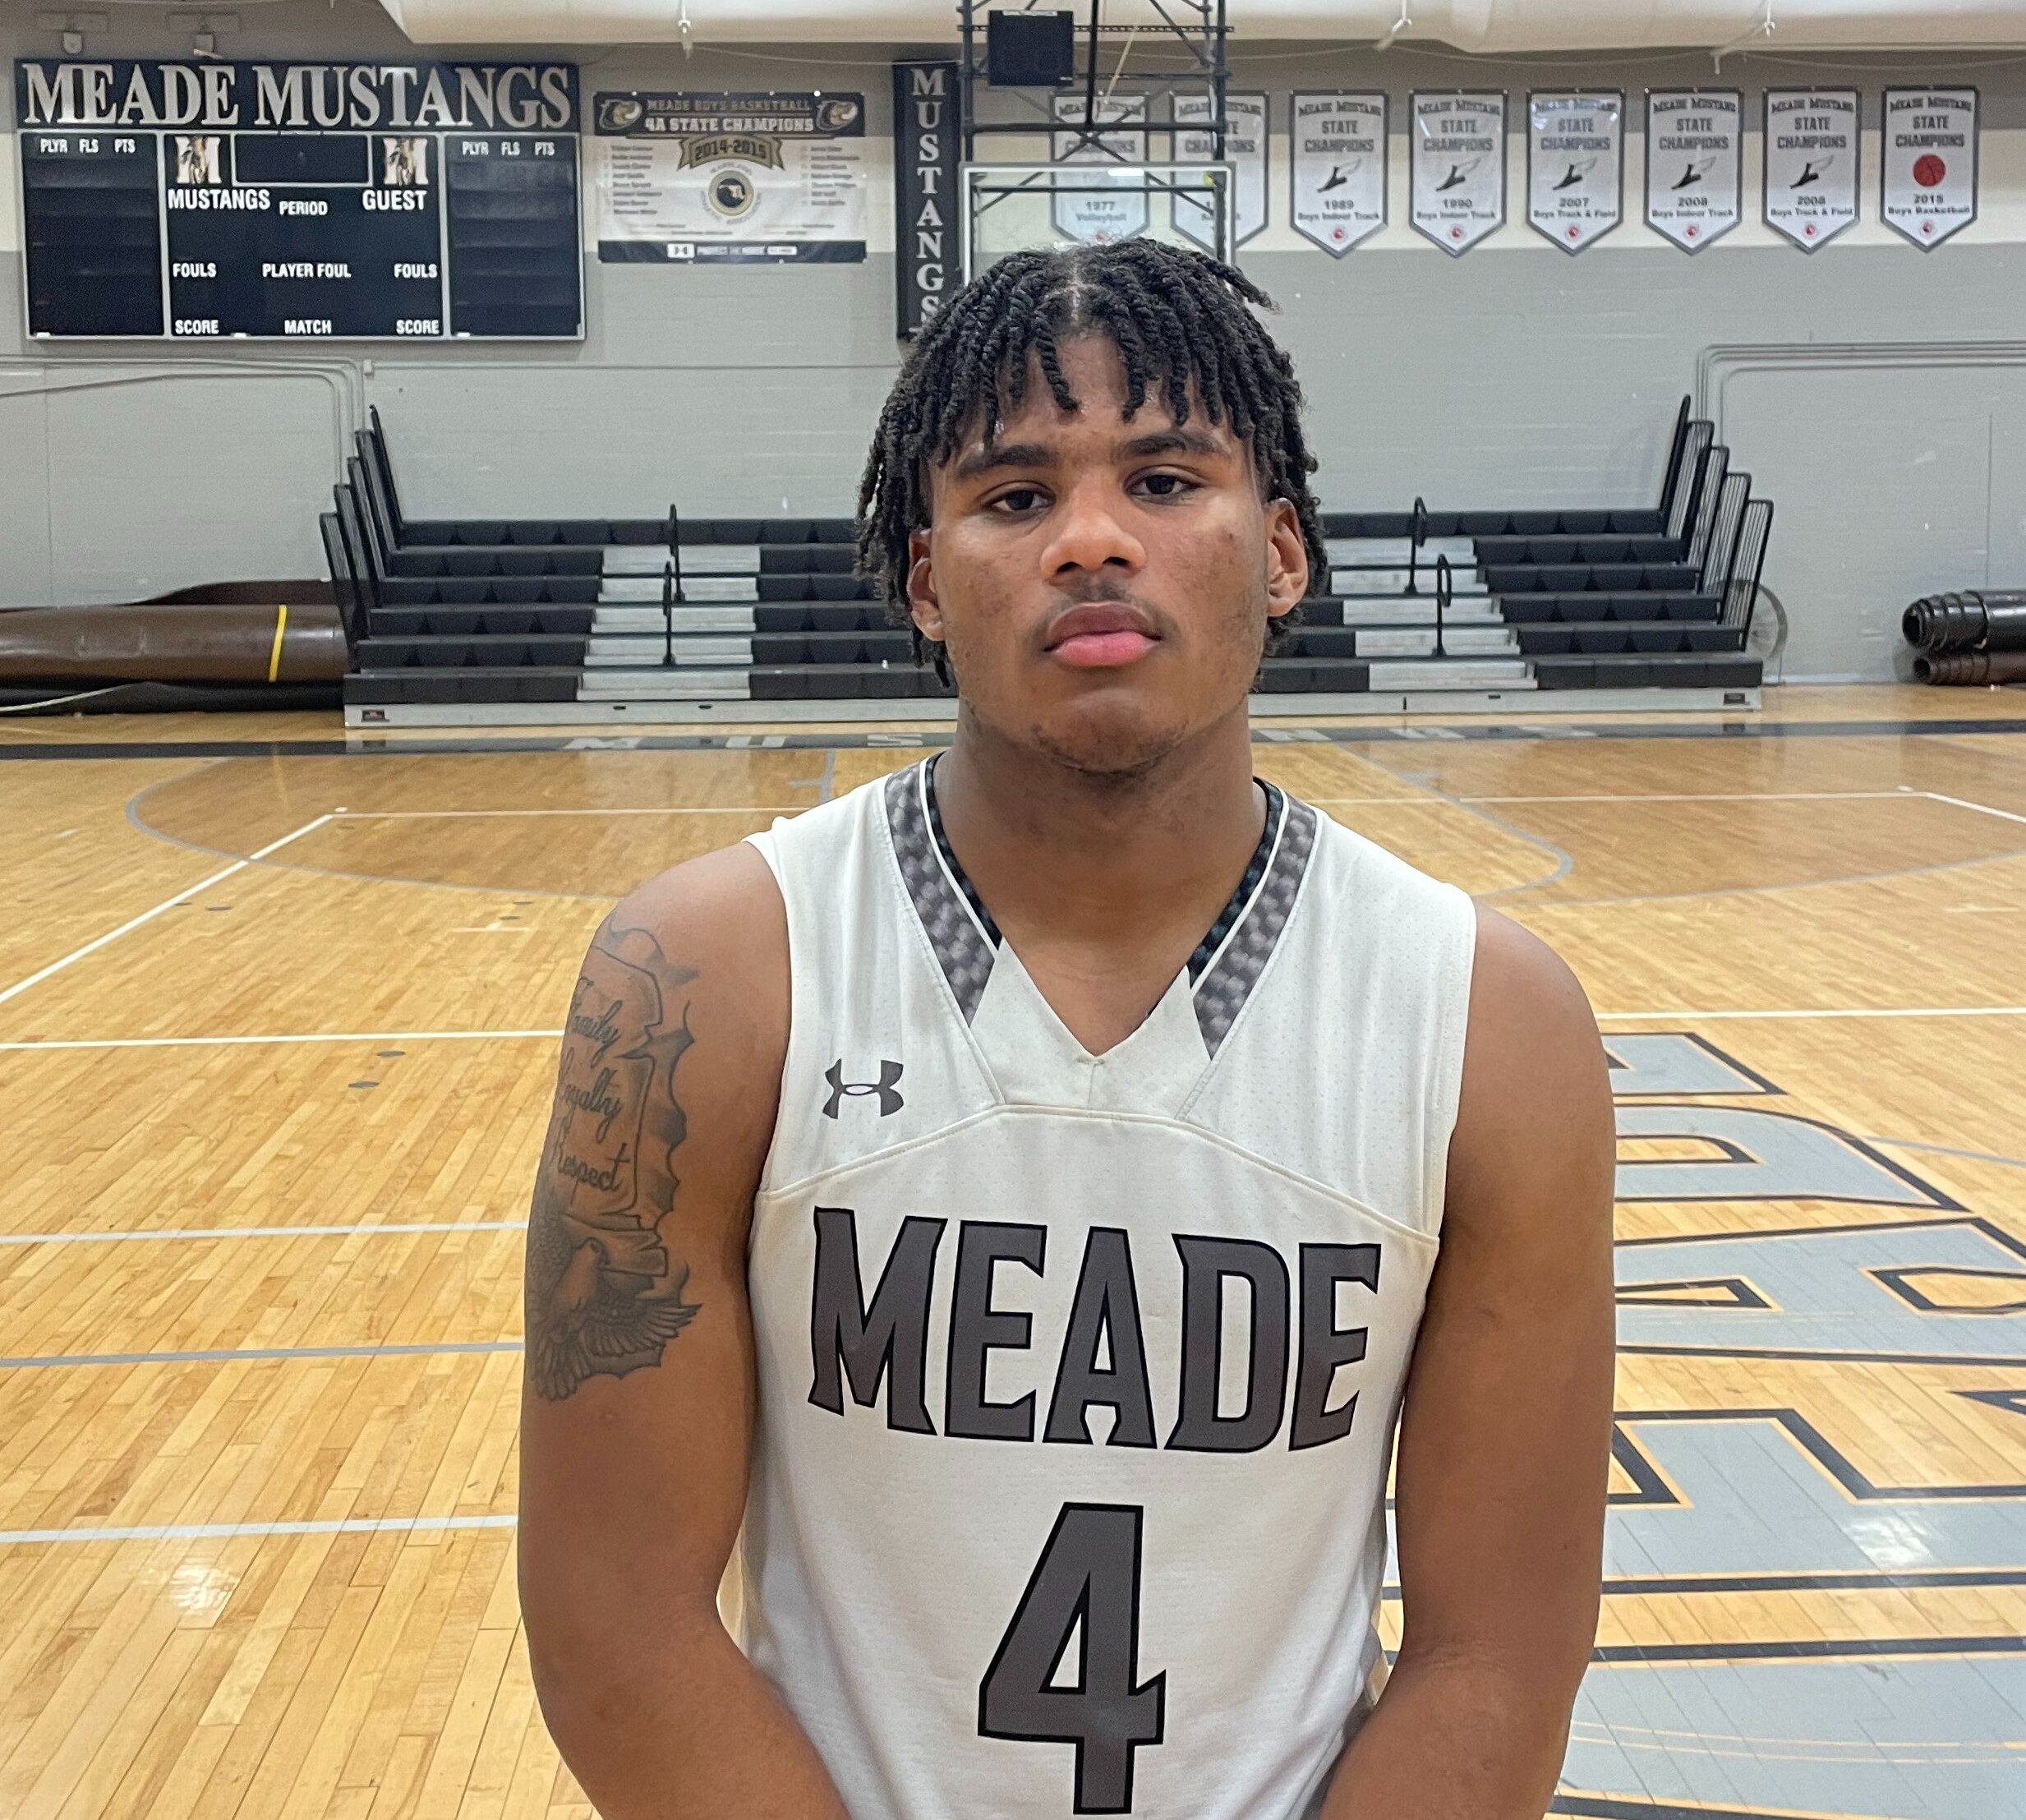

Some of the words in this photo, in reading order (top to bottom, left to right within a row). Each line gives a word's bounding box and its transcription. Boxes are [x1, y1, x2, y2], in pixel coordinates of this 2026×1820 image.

[22, 63, 239, 125] MEADE
[253, 64, 571, 129] MUSTANGS
[670, 118, 719, 131] STATE
[723, 117, 814, 132] CHAMPIONS
[1321, 120, 1358, 134] STATE
[1440, 119, 1477, 133] STATE
[1558, 117, 1595, 132] STATE
[1676, 117, 1713, 132] STATE
[1794, 117, 1830, 131] STATE
[1913, 116, 1949, 130] STATE
[39, 138, 67, 154] PLYR
[78, 139, 99, 154] FLS
[114, 138, 136, 154] PTS
[1305, 139, 1374, 153] CHAMPIONS
[1423, 138, 1494, 152] CHAMPIONS
[1540, 136, 1611, 150] CHAMPIONS
[1659, 136, 1729, 150] CHAMPIONS
[1777, 135, 1847, 149] CHAMPIONS
[1895, 134, 1965, 148] CHAMPIONS
[462, 141, 489, 156] PLYR
[500, 141, 521, 156] FLS
[534, 141, 555, 157] PTS
[695, 139, 767, 161] 2014-2015
[168, 190, 271, 211] MUSTANGS
[362, 189, 427, 211] GUEST
[1086, 201, 1116, 211] 1977
[279, 200, 329, 216] PERIOD
[173, 262, 217, 278] FOULS
[262, 262, 314, 278] PLAYER
[316, 262, 352, 278] FOUL
[394, 263, 438, 279] FOULS
[175, 320, 219, 335] SCORE
[284, 320, 332, 335] MATCH
[396, 320, 440, 335] SCORE
[807, 1205, 1382, 1454] MEADE
[978, 1501, 1167, 1815] 4
